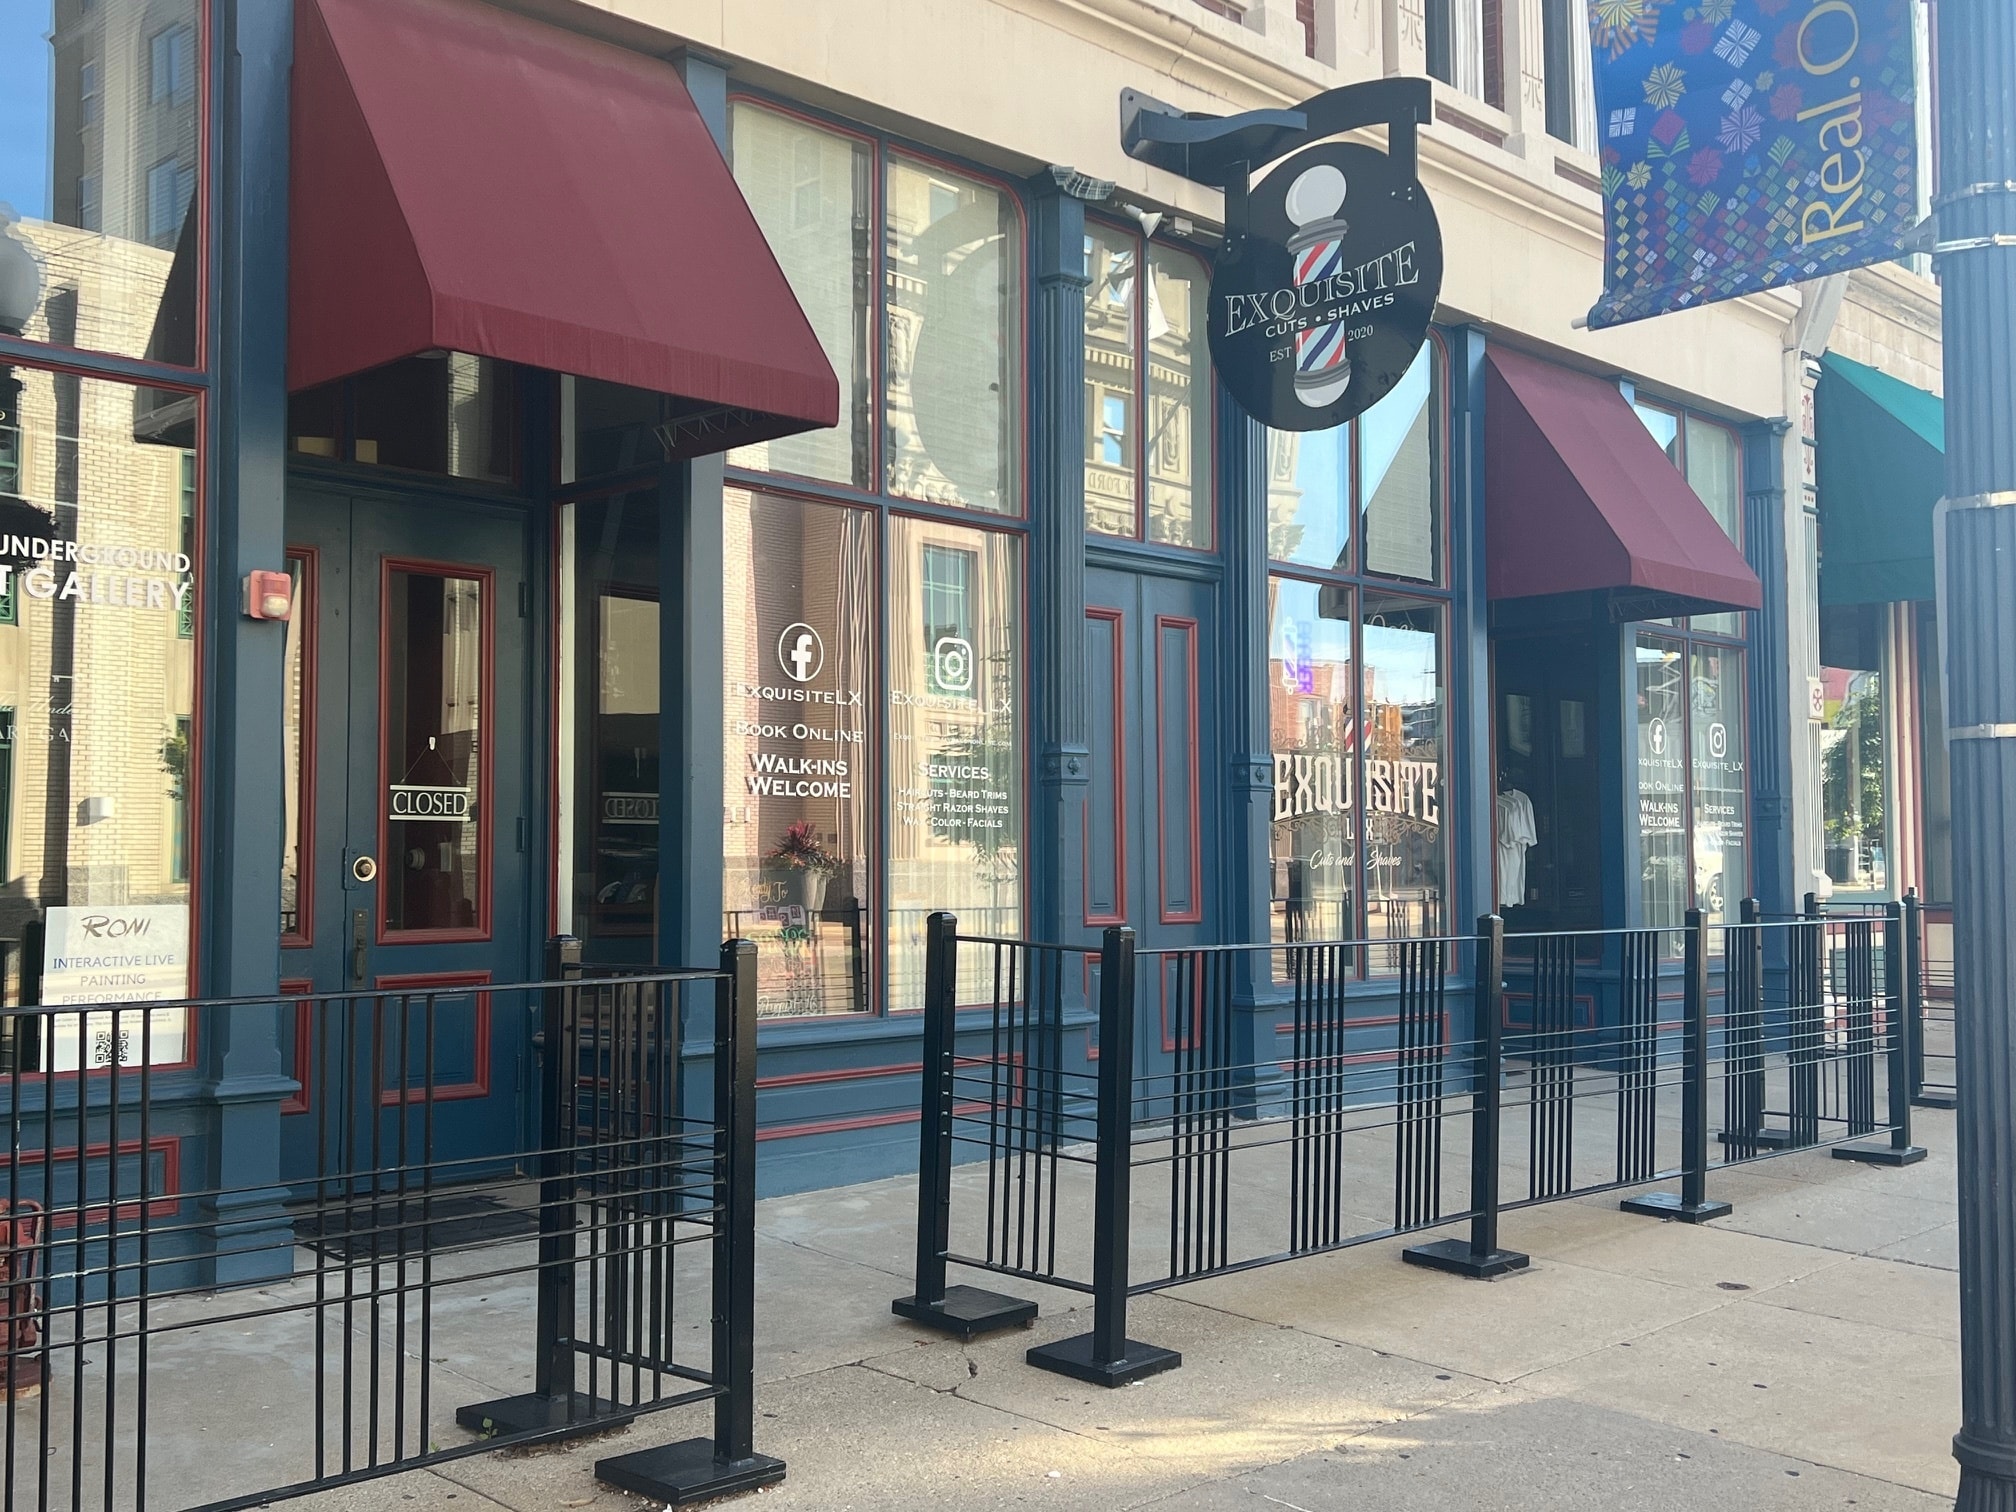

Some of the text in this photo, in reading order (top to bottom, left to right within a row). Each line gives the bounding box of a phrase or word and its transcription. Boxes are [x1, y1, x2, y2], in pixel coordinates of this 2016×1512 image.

[1225, 241, 1420, 337] EXQUISITE
[1265, 292, 1395, 338] CUTS SHAVES
[1269, 324, 1374, 362] EST 2020
[25, 567, 190, 611] GALLERY
[736, 721, 864, 743] BOOK ONLINE
[750, 753, 848, 776] WALK-INS
[918, 762, 989, 779] SERVICES
[1638, 758, 1684, 768] XQUISITELX
[747, 776, 851, 798] WELCOME
[949, 788, 980, 799] BEARD
[981, 789, 1008, 800] TRIMS
[1273, 753, 1439, 825] EXQUISITE
[1638, 781, 1653, 790] OOK
[393, 791, 468, 815] CLOSED
[943, 802, 974, 813] RAZOR
[975, 803, 1009, 814] SHAVES
[1640, 799, 1679, 813] WALK-INS
[1704, 803, 1735, 815] SERVICES
[931, 817, 962, 827] COLOR
[967, 817, 1003, 828] FACIALS
[1639, 813, 1681, 827] WELCOME
[1309, 849, 1334, 870] Cuts
[53, 954, 175, 969] INTERACTIVE LIVE
[80, 973, 146, 987] PAINTING
